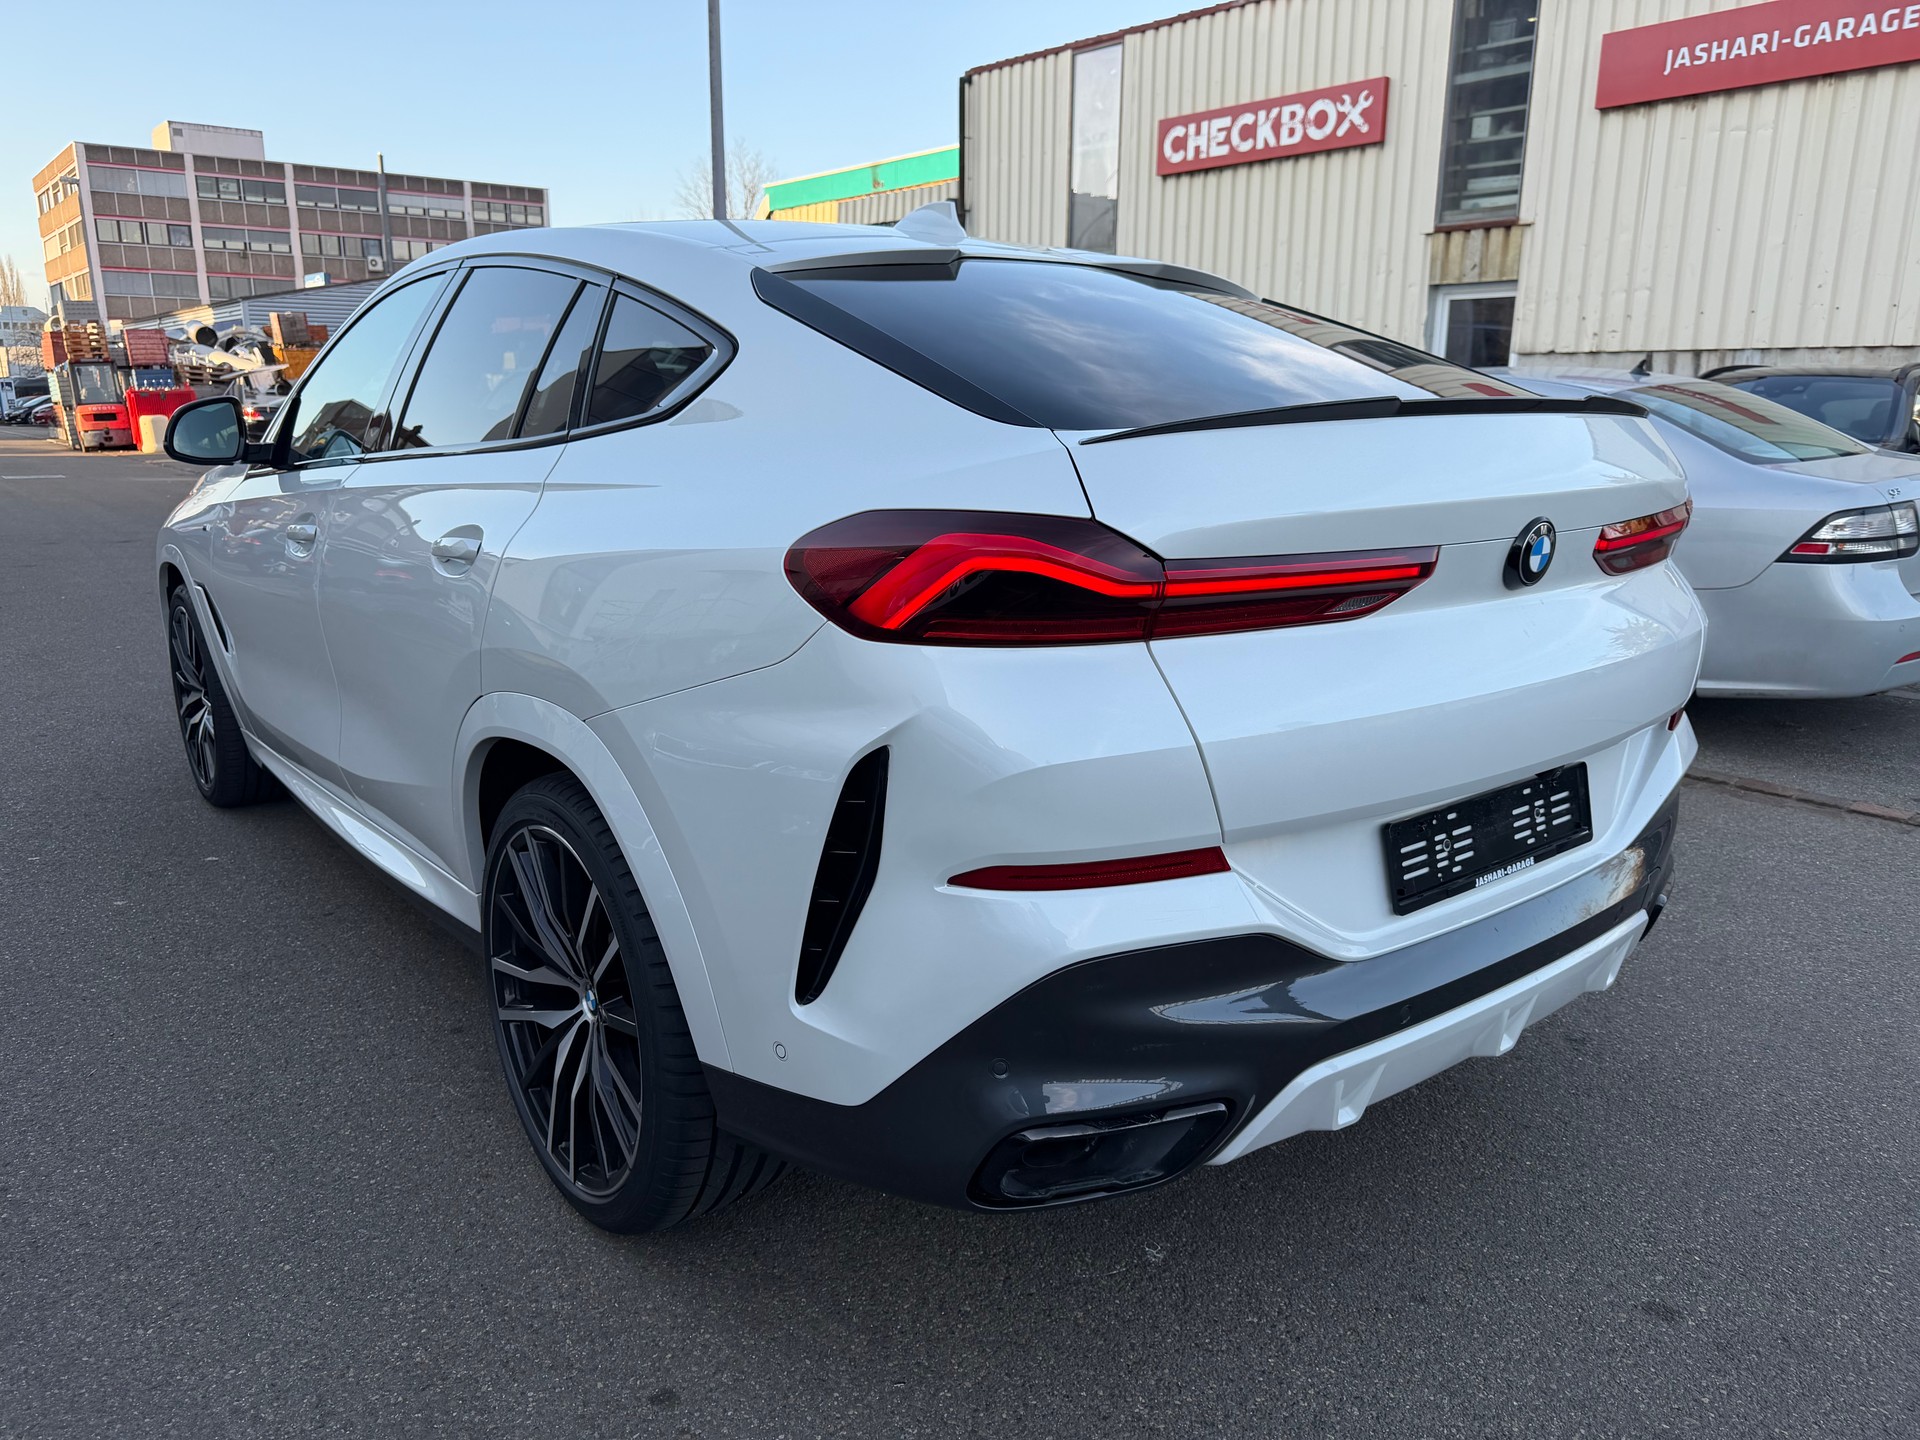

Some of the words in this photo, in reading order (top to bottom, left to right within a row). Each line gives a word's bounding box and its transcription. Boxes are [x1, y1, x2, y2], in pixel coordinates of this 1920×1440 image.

[1663, 4, 1920, 76] JASHARI-GARAGE
[1163, 89, 1375, 164] CHECKBOX
[1475, 856, 1535, 887] JASHARI-GARAGE
